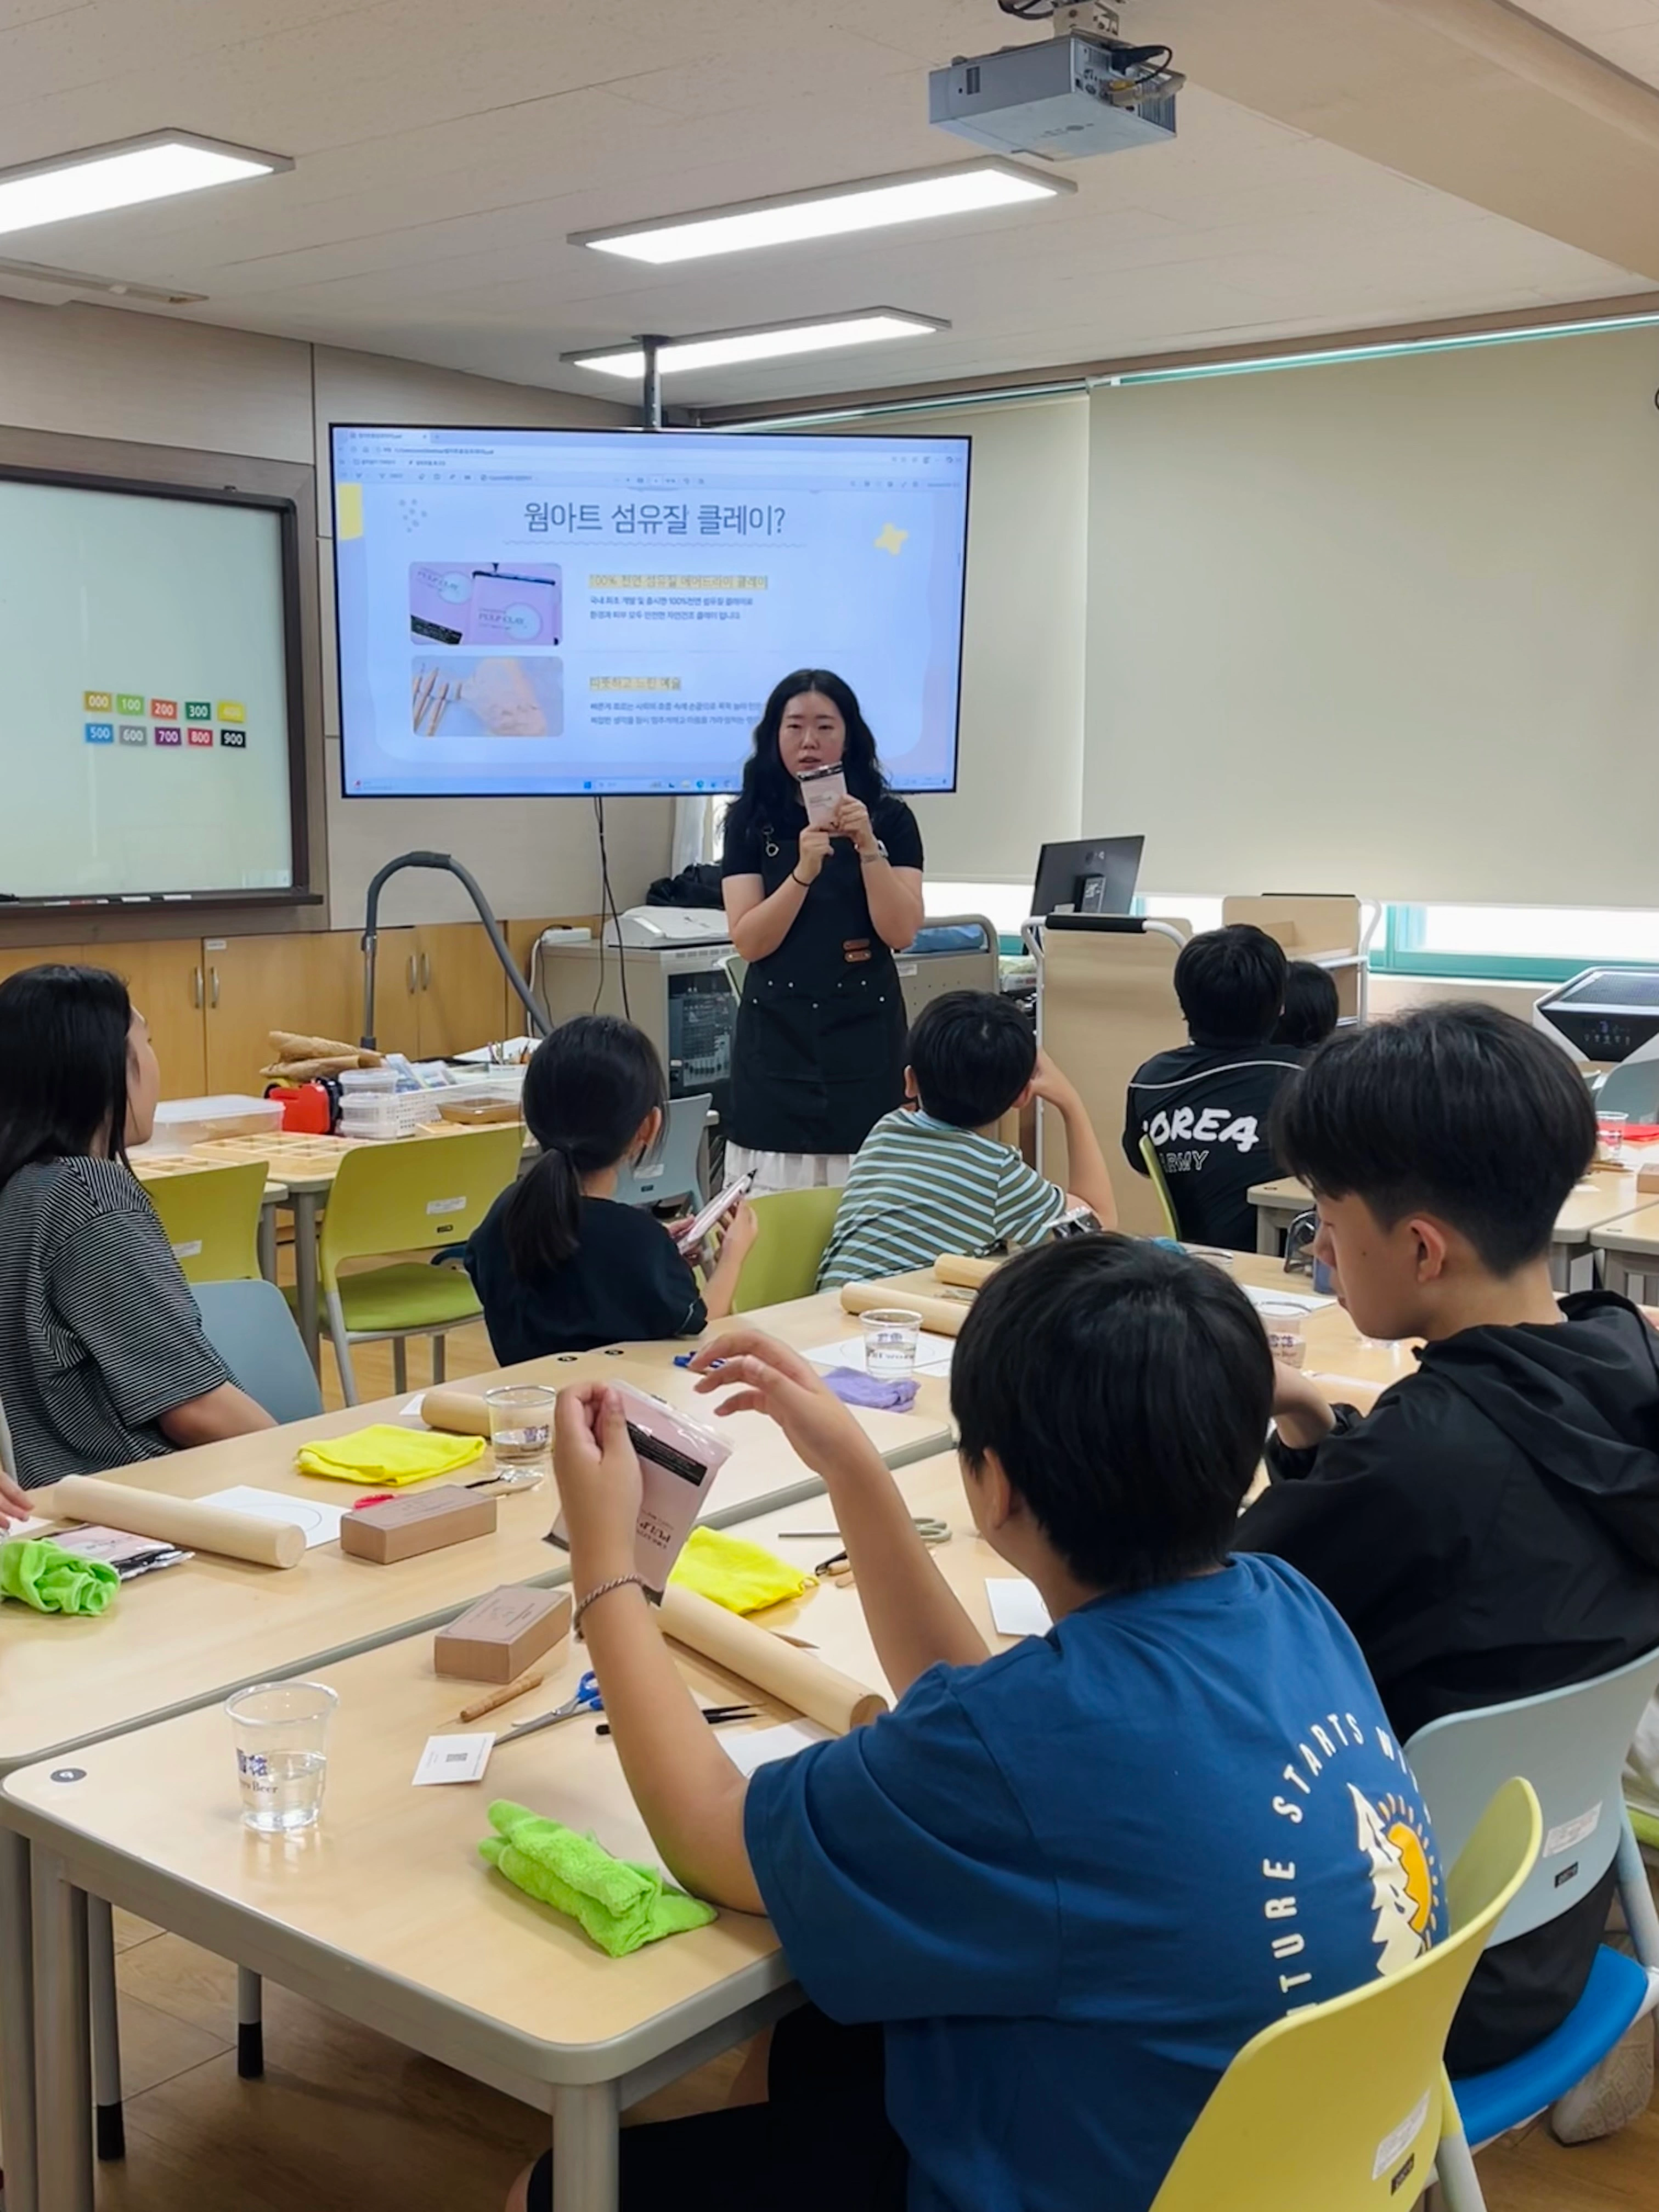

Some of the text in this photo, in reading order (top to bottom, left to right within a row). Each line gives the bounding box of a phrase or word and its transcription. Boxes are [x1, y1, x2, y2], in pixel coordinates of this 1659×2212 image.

[524, 502, 785, 535] 웜아트 섬유질 클레이?
[88, 695, 109, 708] 000
[122, 698, 142, 710] 100
[155, 703, 174, 716] 200
[189, 706, 208, 718] 300
[89, 726, 243, 745] 500 600 700 800 900
[1158, 1150, 1209, 1173] RMY
[1272, 1712, 1365, 1824] STARTS
